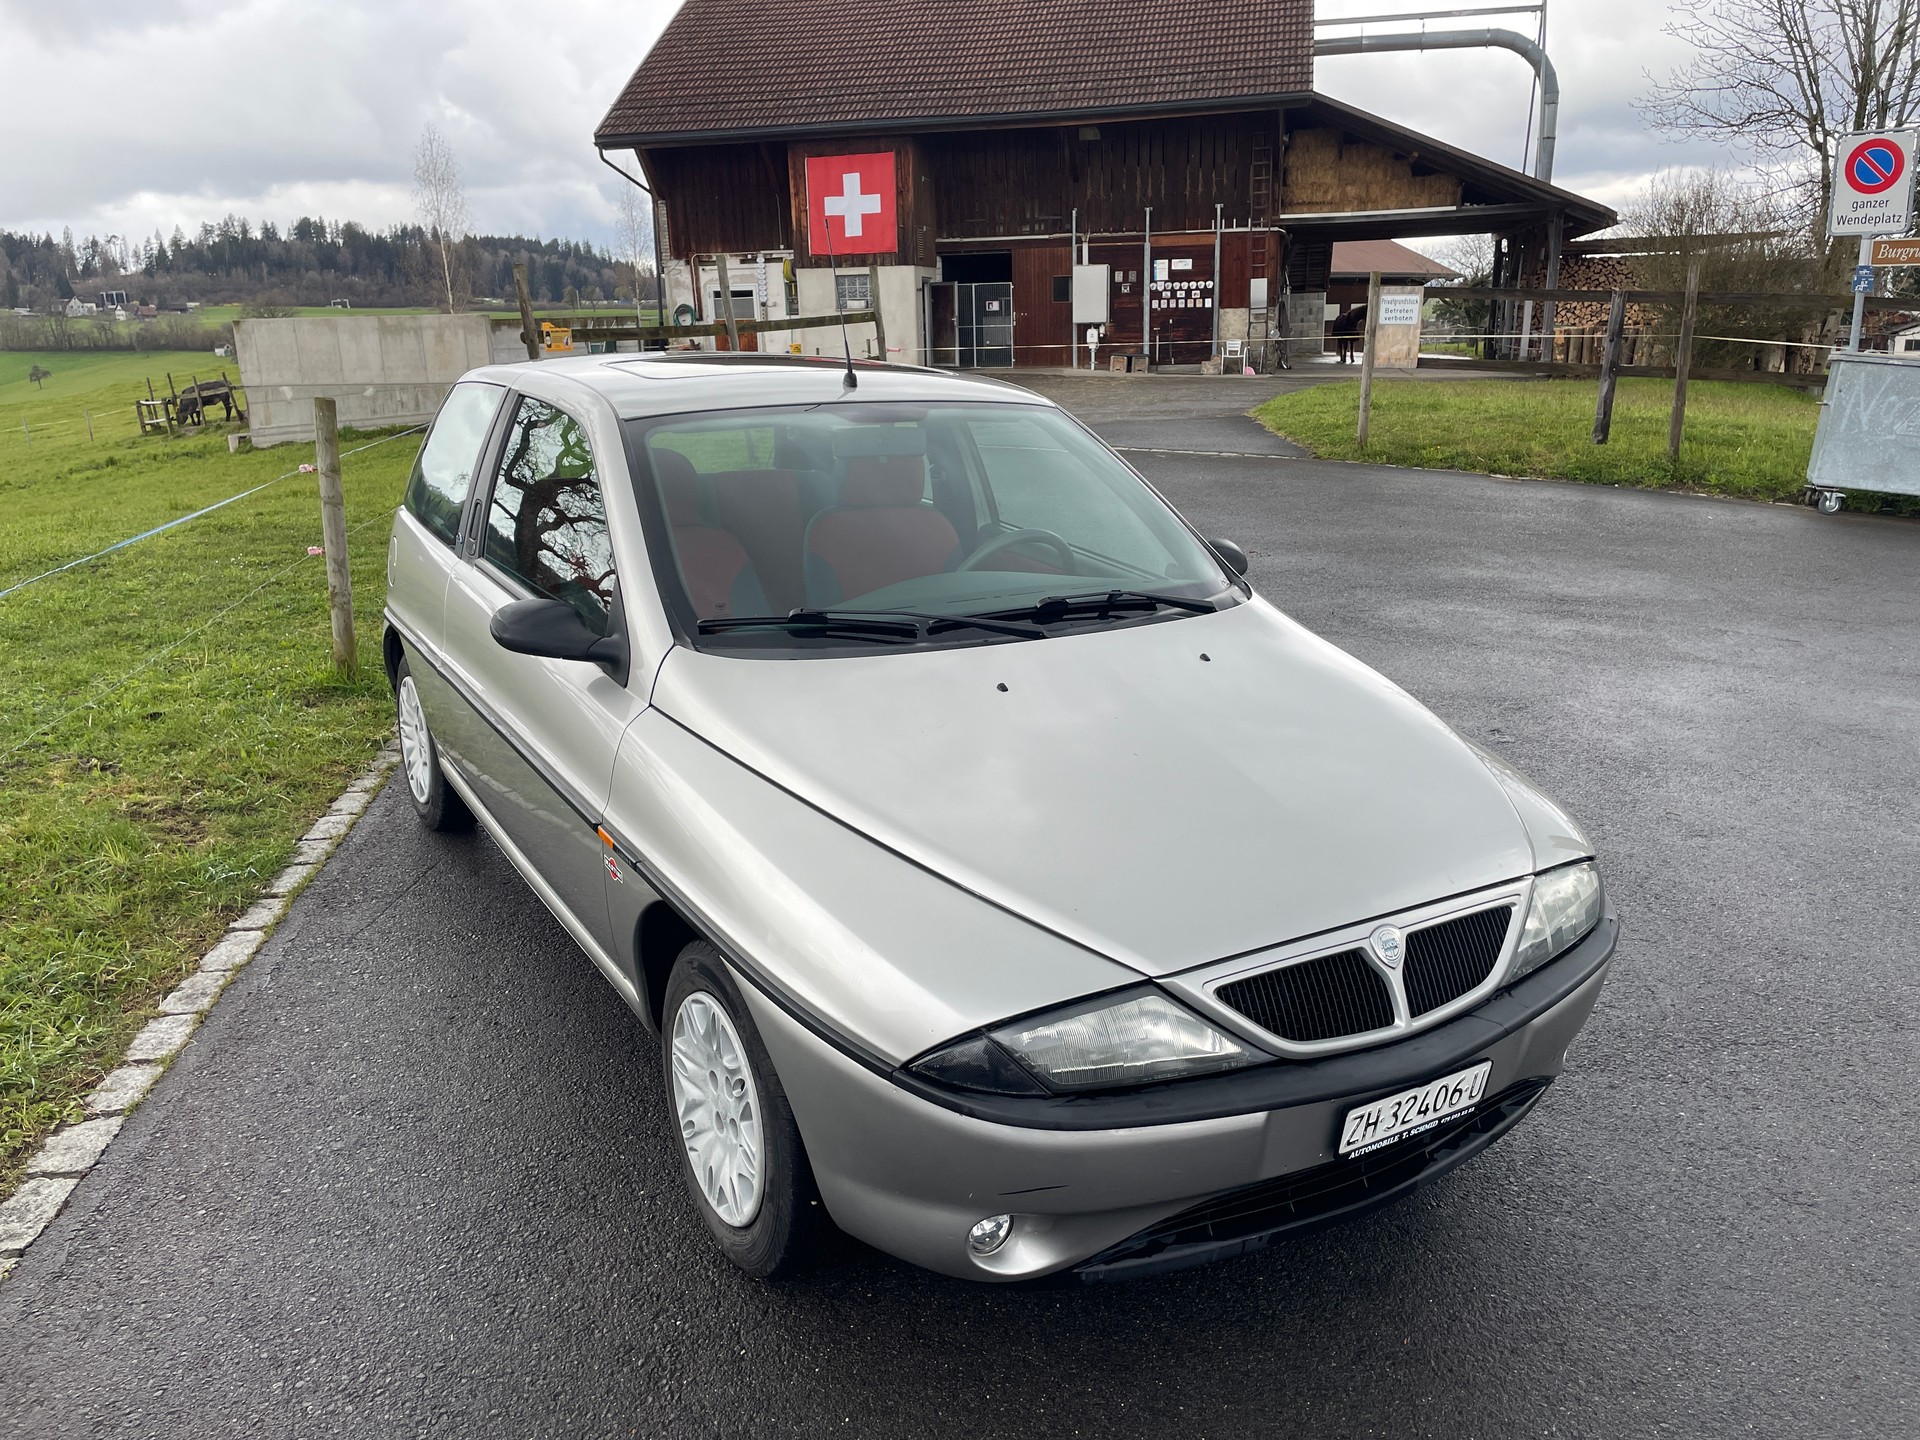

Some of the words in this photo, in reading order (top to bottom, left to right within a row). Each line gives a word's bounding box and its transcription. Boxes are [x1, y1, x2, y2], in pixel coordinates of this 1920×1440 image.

[1852, 199, 1889, 212] ganzer
[1836, 213, 1902, 227] Wendeplatz
[1348, 1135, 1399, 1159] AUTOMOBILE
[1409, 1120, 1438, 1136] SCHMID
